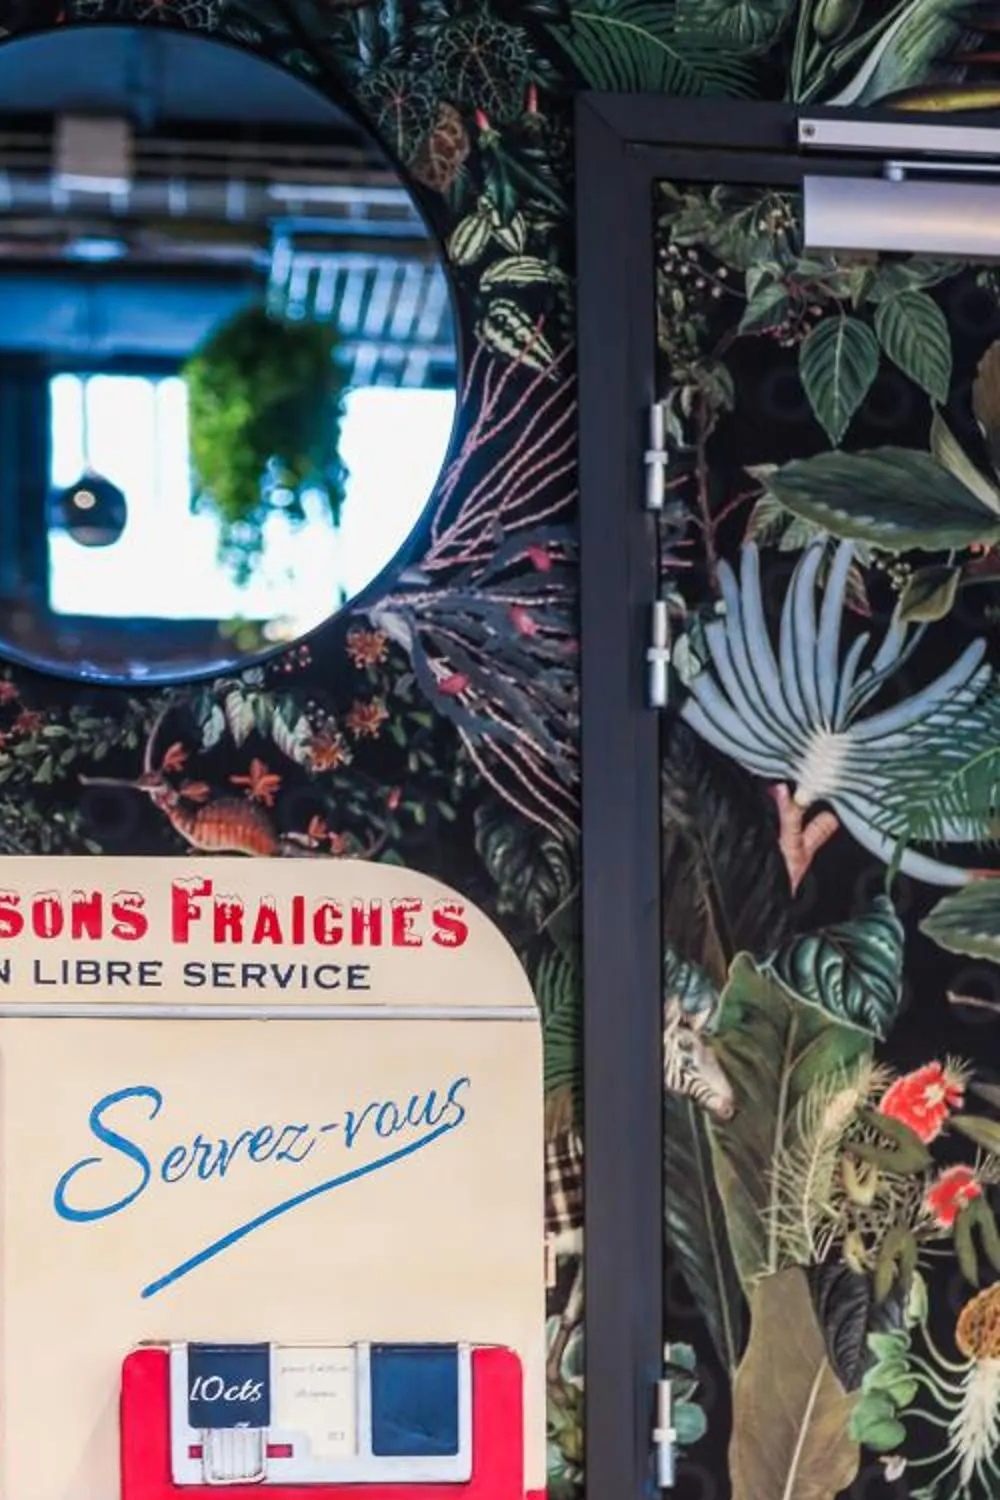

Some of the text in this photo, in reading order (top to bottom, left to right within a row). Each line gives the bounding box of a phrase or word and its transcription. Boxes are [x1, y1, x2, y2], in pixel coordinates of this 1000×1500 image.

[33, 959, 163, 987] LIBRE
[183, 961, 372, 990] SERVICE
[54, 1076, 471, 1223] Servez-vous
